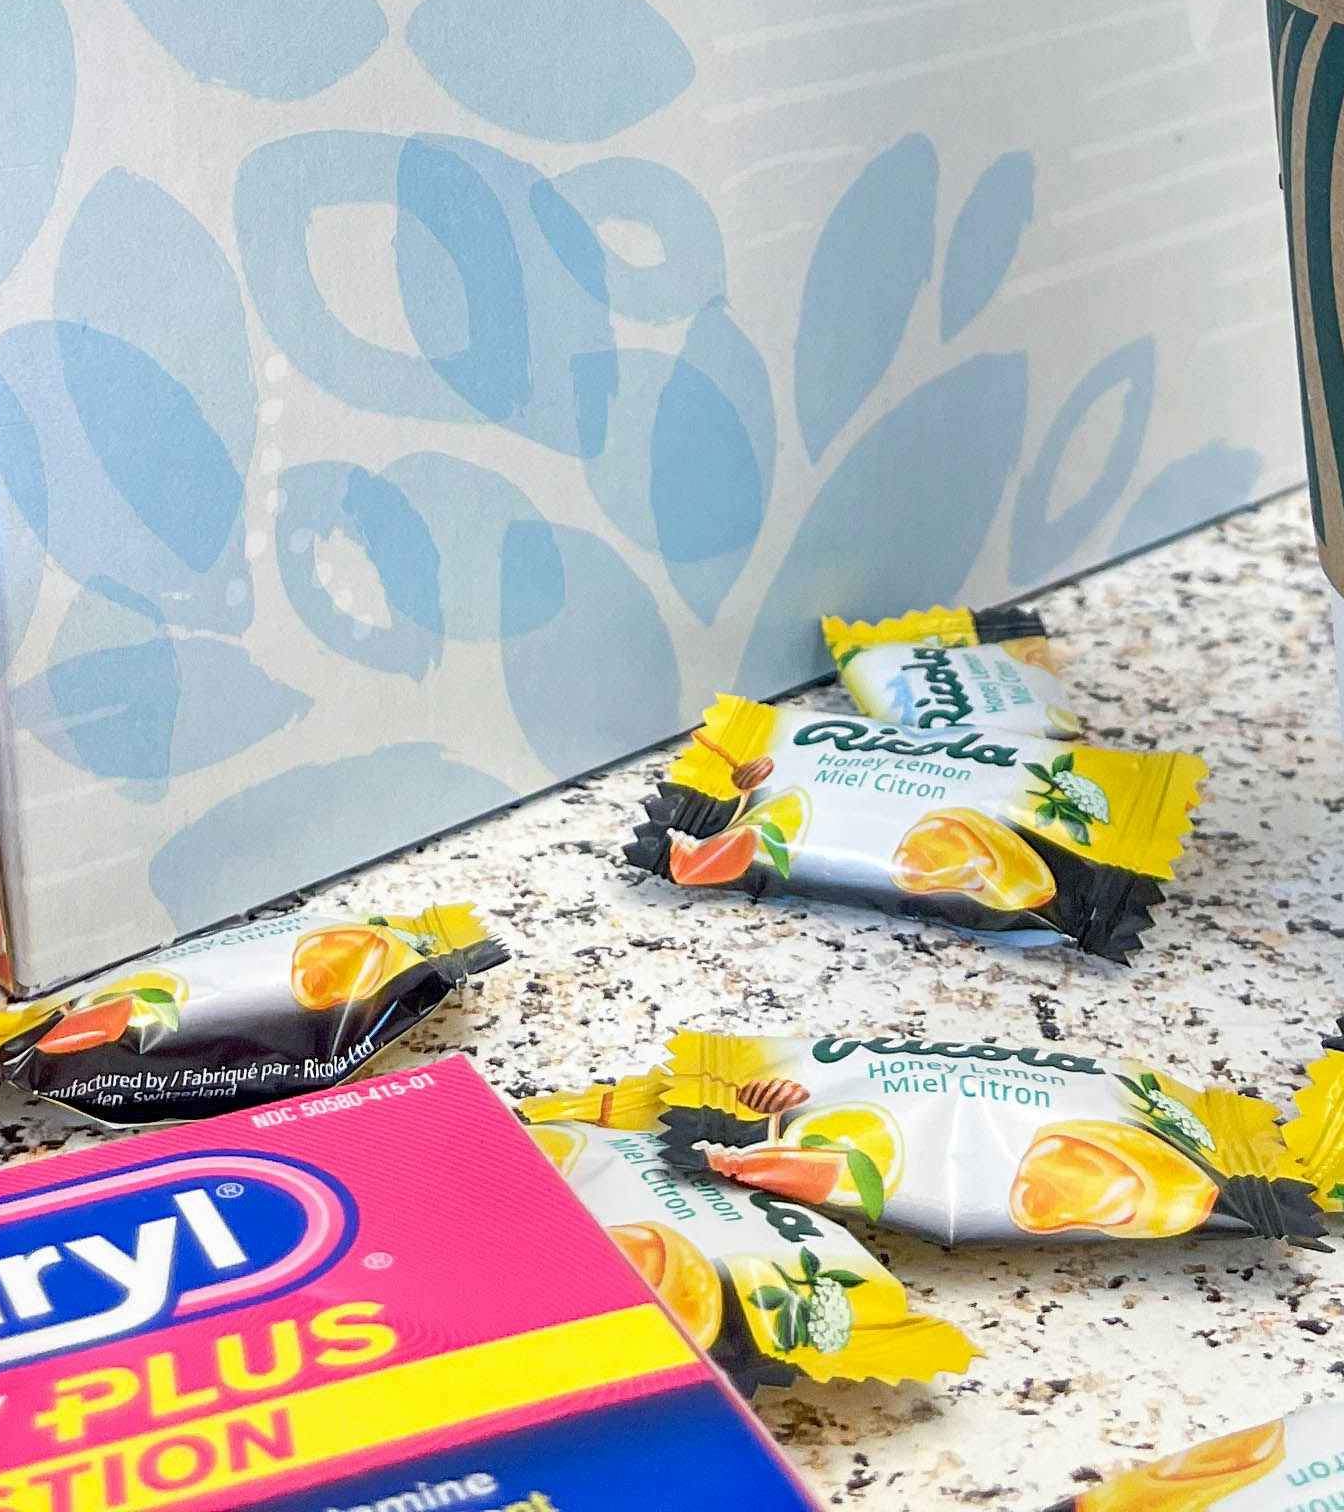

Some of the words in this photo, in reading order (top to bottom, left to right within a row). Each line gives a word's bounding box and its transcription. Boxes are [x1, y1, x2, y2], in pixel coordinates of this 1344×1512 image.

[792, 720, 1019, 768] Ricola
[814, 768, 868, 788] Miel
[873, 772, 946, 800] Citron
[818, 753, 888, 770] Honey
[893, 754, 972, 782] Lemon
[43, 1073, 143, 1099] nufactured
[147, 1071, 167, 1090] by
[183, 1062, 256, 1089] Fabriqué
[261, 1062, 289, 1084] par
[304, 1054, 347, 1078] Ricola
[867, 1060, 958, 1078] Honey
[971, 1063, 1066, 1086] Lemon
[883, 1074, 948, 1094] Miel
[960, 1075, 1051, 1108] Citron
[250, 1107, 297, 1129] NDC
[299, 1072, 436, 1118] 50580-415-01
[606, 1139, 655, 1165] Miel
[641, 1169, 698, 1221] Citron
